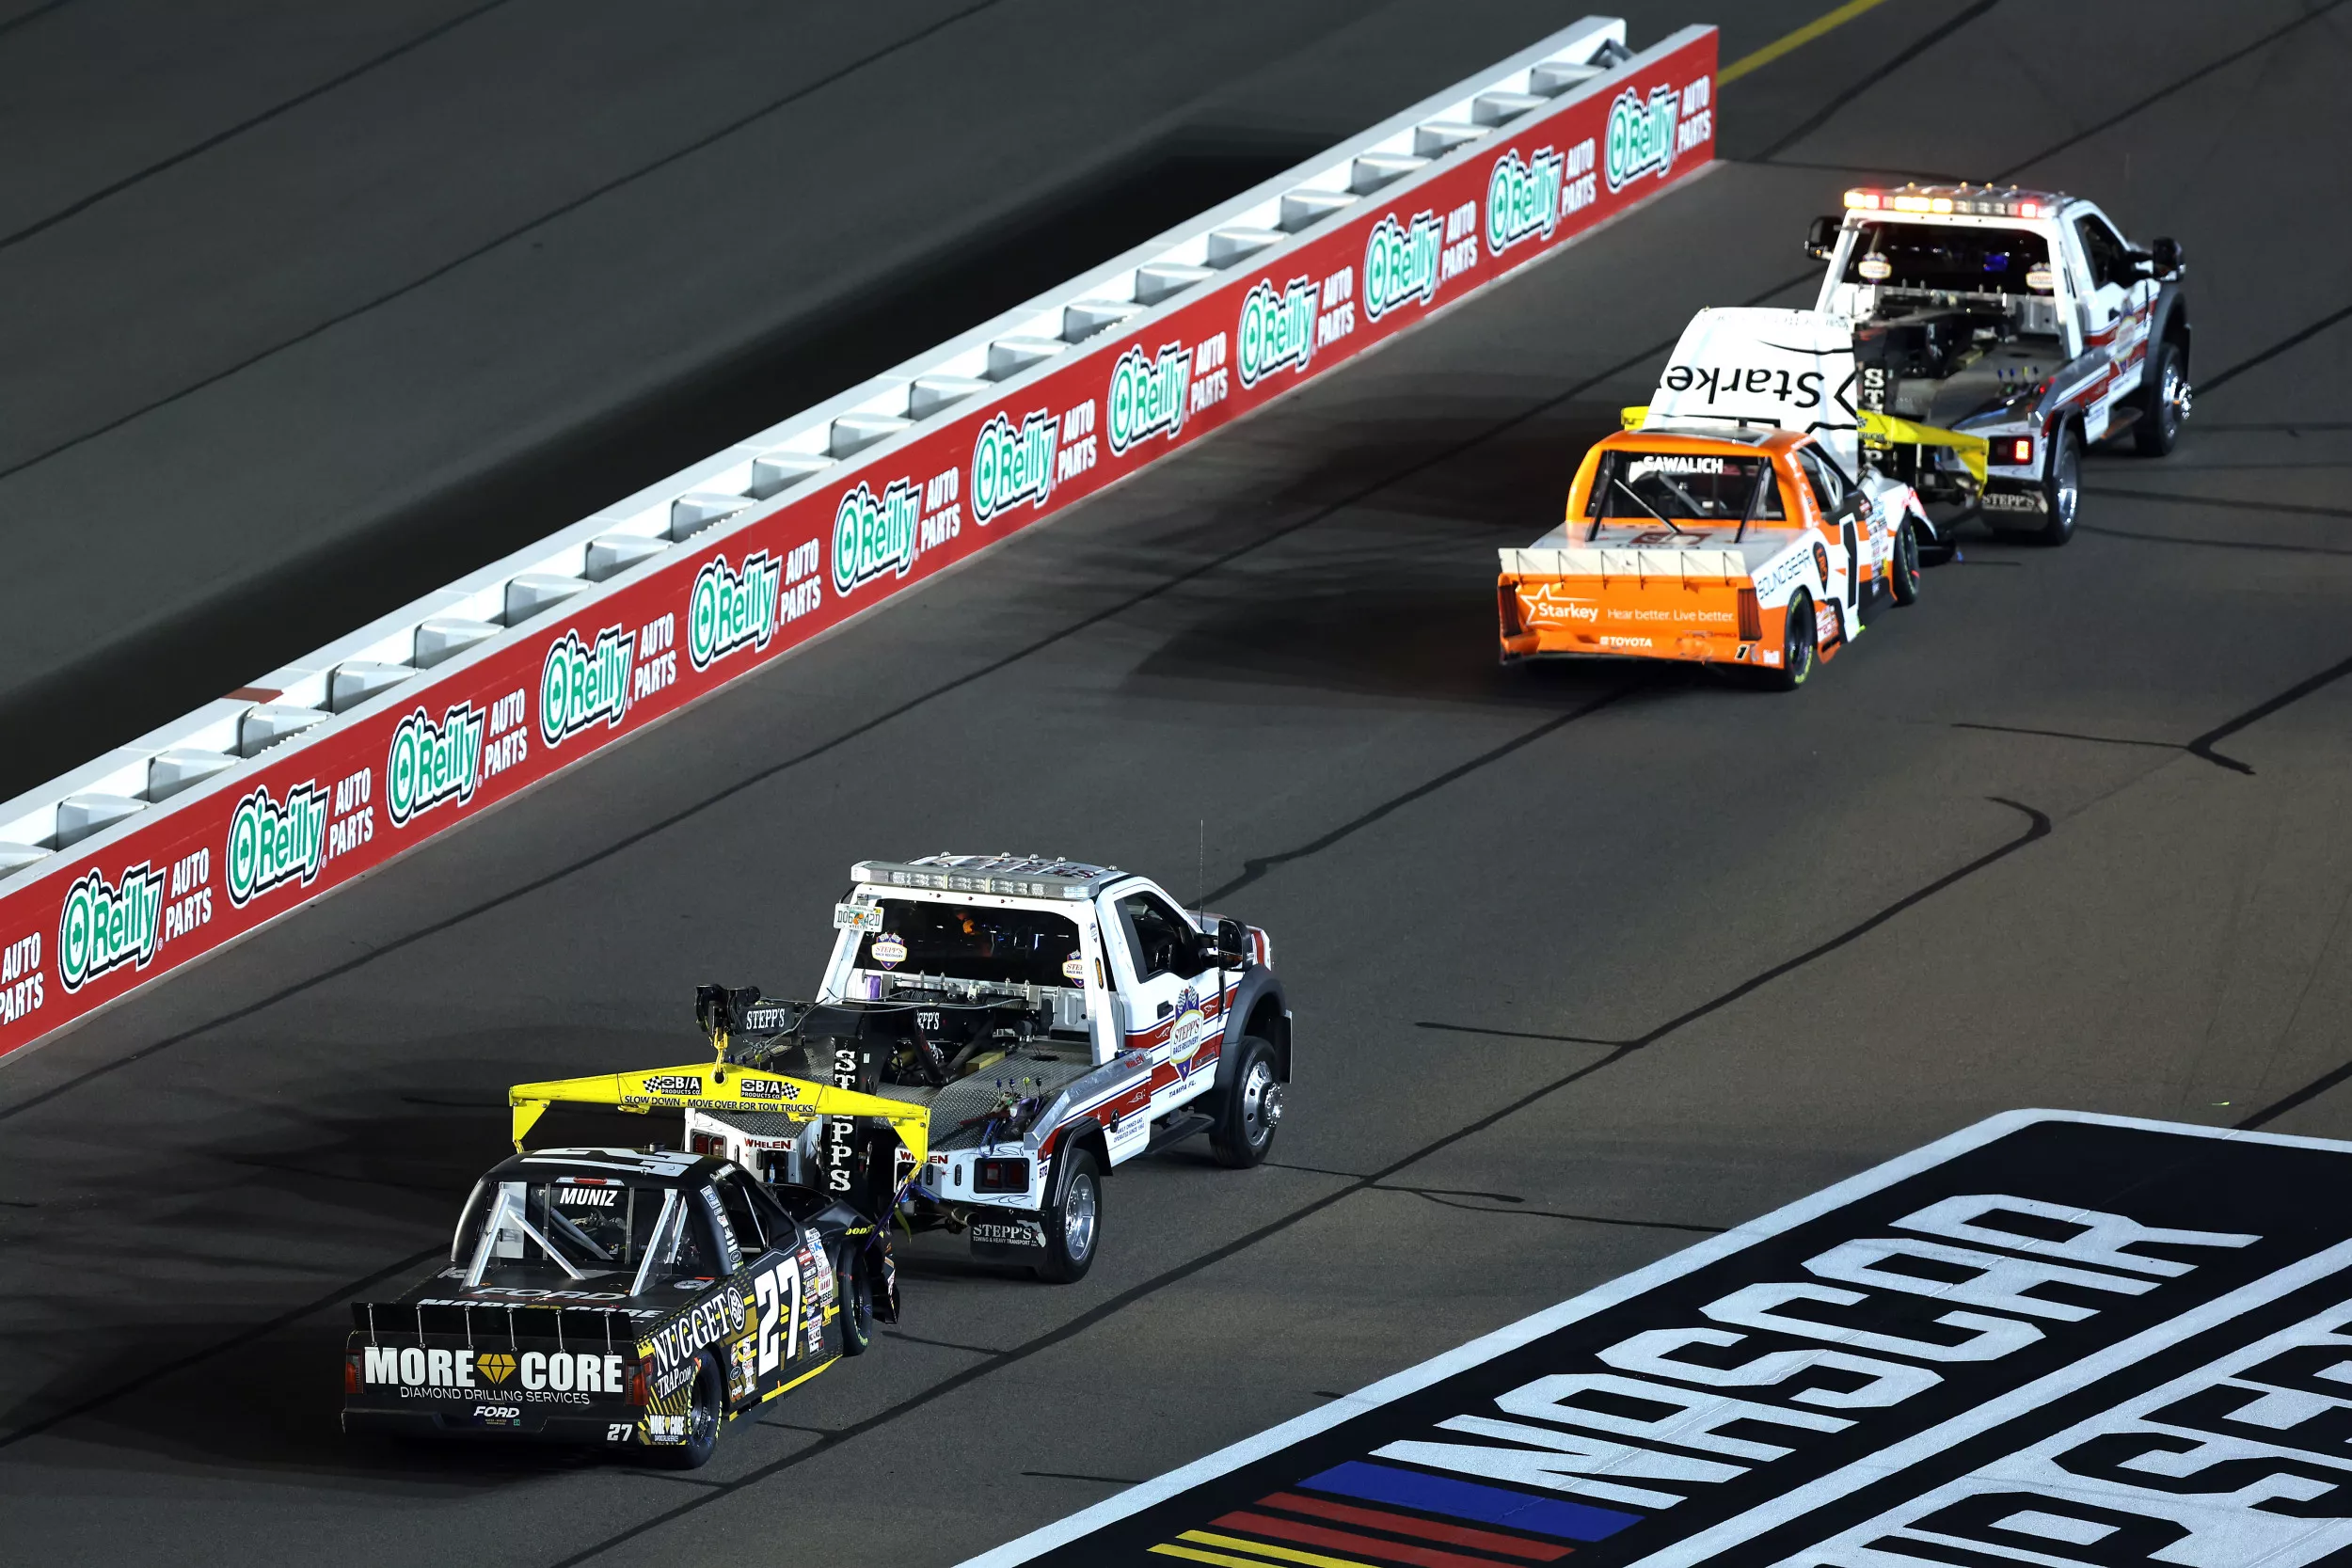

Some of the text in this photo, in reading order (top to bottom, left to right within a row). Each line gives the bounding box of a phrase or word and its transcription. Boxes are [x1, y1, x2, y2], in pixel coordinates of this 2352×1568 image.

[1681, 75, 1710, 118] AUTO
[1609, 104, 1672, 177] O'Reilly
[1677, 110, 1712, 154] PARTS
[1565, 137, 1596, 180] AUTO
[1491, 166, 1556, 245] O'Reilly
[1561, 173, 1597, 218] PARTS
[1446, 199, 1476, 244] AUTO
[1369, 230, 1437, 309] O'Reilly
[1441, 234, 1478, 281] PARTS
[1322, 266, 1354, 310] AUTO
[1242, 293, 1311, 376] O'Reilly
[1317, 301, 1355, 348] PARTS
[1194, 331, 1227, 376] AUTO
[1113, 362, 1185, 441] O'Reilly
[1190, 367, 1229, 415] PARTS
[1062, 399, 1095, 444] AUTO
[977, 429, 1053, 512] O'Reilly
[1057, 435, 1097, 484] PARTS
[1643, 455, 1724, 474] SAWALICH
[925, 467, 959, 513] AUTO
[1982, 492, 2035, 510] STEPP'S
[836, 494, 914, 583] O'Reilly
[920, 502, 961, 553] PARTS
[785, 538, 819, 586] AUTO
[1757, 548, 1812, 600] SOUNDGEAR
[693, 571, 778, 656] O'Reilly
[780, 575, 821, 626] PARTS
[1538, 602, 1599, 623] Starkey
[1607, 609, 1735, 623] Hear better. Live better.
[640, 612, 675, 661] AUTO
[1610, 637, 1653, 648] TOYOTA
[1735, 643, 1750, 659] 1
[546, 647, 629, 733] O'Reilly
[634, 649, 676, 702] PARTS
[489, 689, 525, 737] AUTO
[393, 723, 478, 811] O'Reilly
[484, 729, 528, 780] PARTS
[334, 767, 372, 816] AUTO
[232, 800, 322, 891] O'Reilly
[329, 805, 373, 859] PARTS
[170, 847, 210, 898] AUTO
[64, 885, 158, 976] O'Reilly
[165, 886, 213, 942] PARTS
[1, 931, 41, 985] AUTO
[875, 945, 903, 954] STEPP'S
[746, 1007, 786, 1031] STEPP'S
[1173, 1018, 1200, 1044] STEPP'S
[625, 1095, 649, 1103] SLOW
[651, 1097, 680, 1106] DOWN
[688, 1099, 713, 1107] MOVE
[714, 1101, 738, 1110] OVER
[739, 1101, 756, 1111] FOR
[757, 1102, 779, 1111] TOW
[781, 1103, 814, 1113] TRUCKS
[675, 1077, 700, 1089] B/A
[755, 1081, 780, 1094] B/A
[1168, 1085, 1187, 1099] TAMPA
[744, 1137, 791, 1149] WHELEN
[830, 1049, 857, 1192] STPPS
[899, 1150, 949, 1164] WHEN
[559, 1187, 618, 1207] MUNIZ
[973, 1223, 1032, 1240] STEPP'S
[1007, 1238, 1031, 1246] TRANSPORT
[470, 1287, 628, 1301] FORD
[756, 1256, 802, 1377] 27
[652, 1293, 730, 1377] NUGGET
[1369, 1195, 2264, 1510] NASCAR
[364, 1346, 624, 1393] MORE CORE
[400, 1386, 590, 1405] DIAMOND DRILLING SERVICES
[473, 1405, 520, 1418] FORD
[607, 1423, 633, 1442] 27
